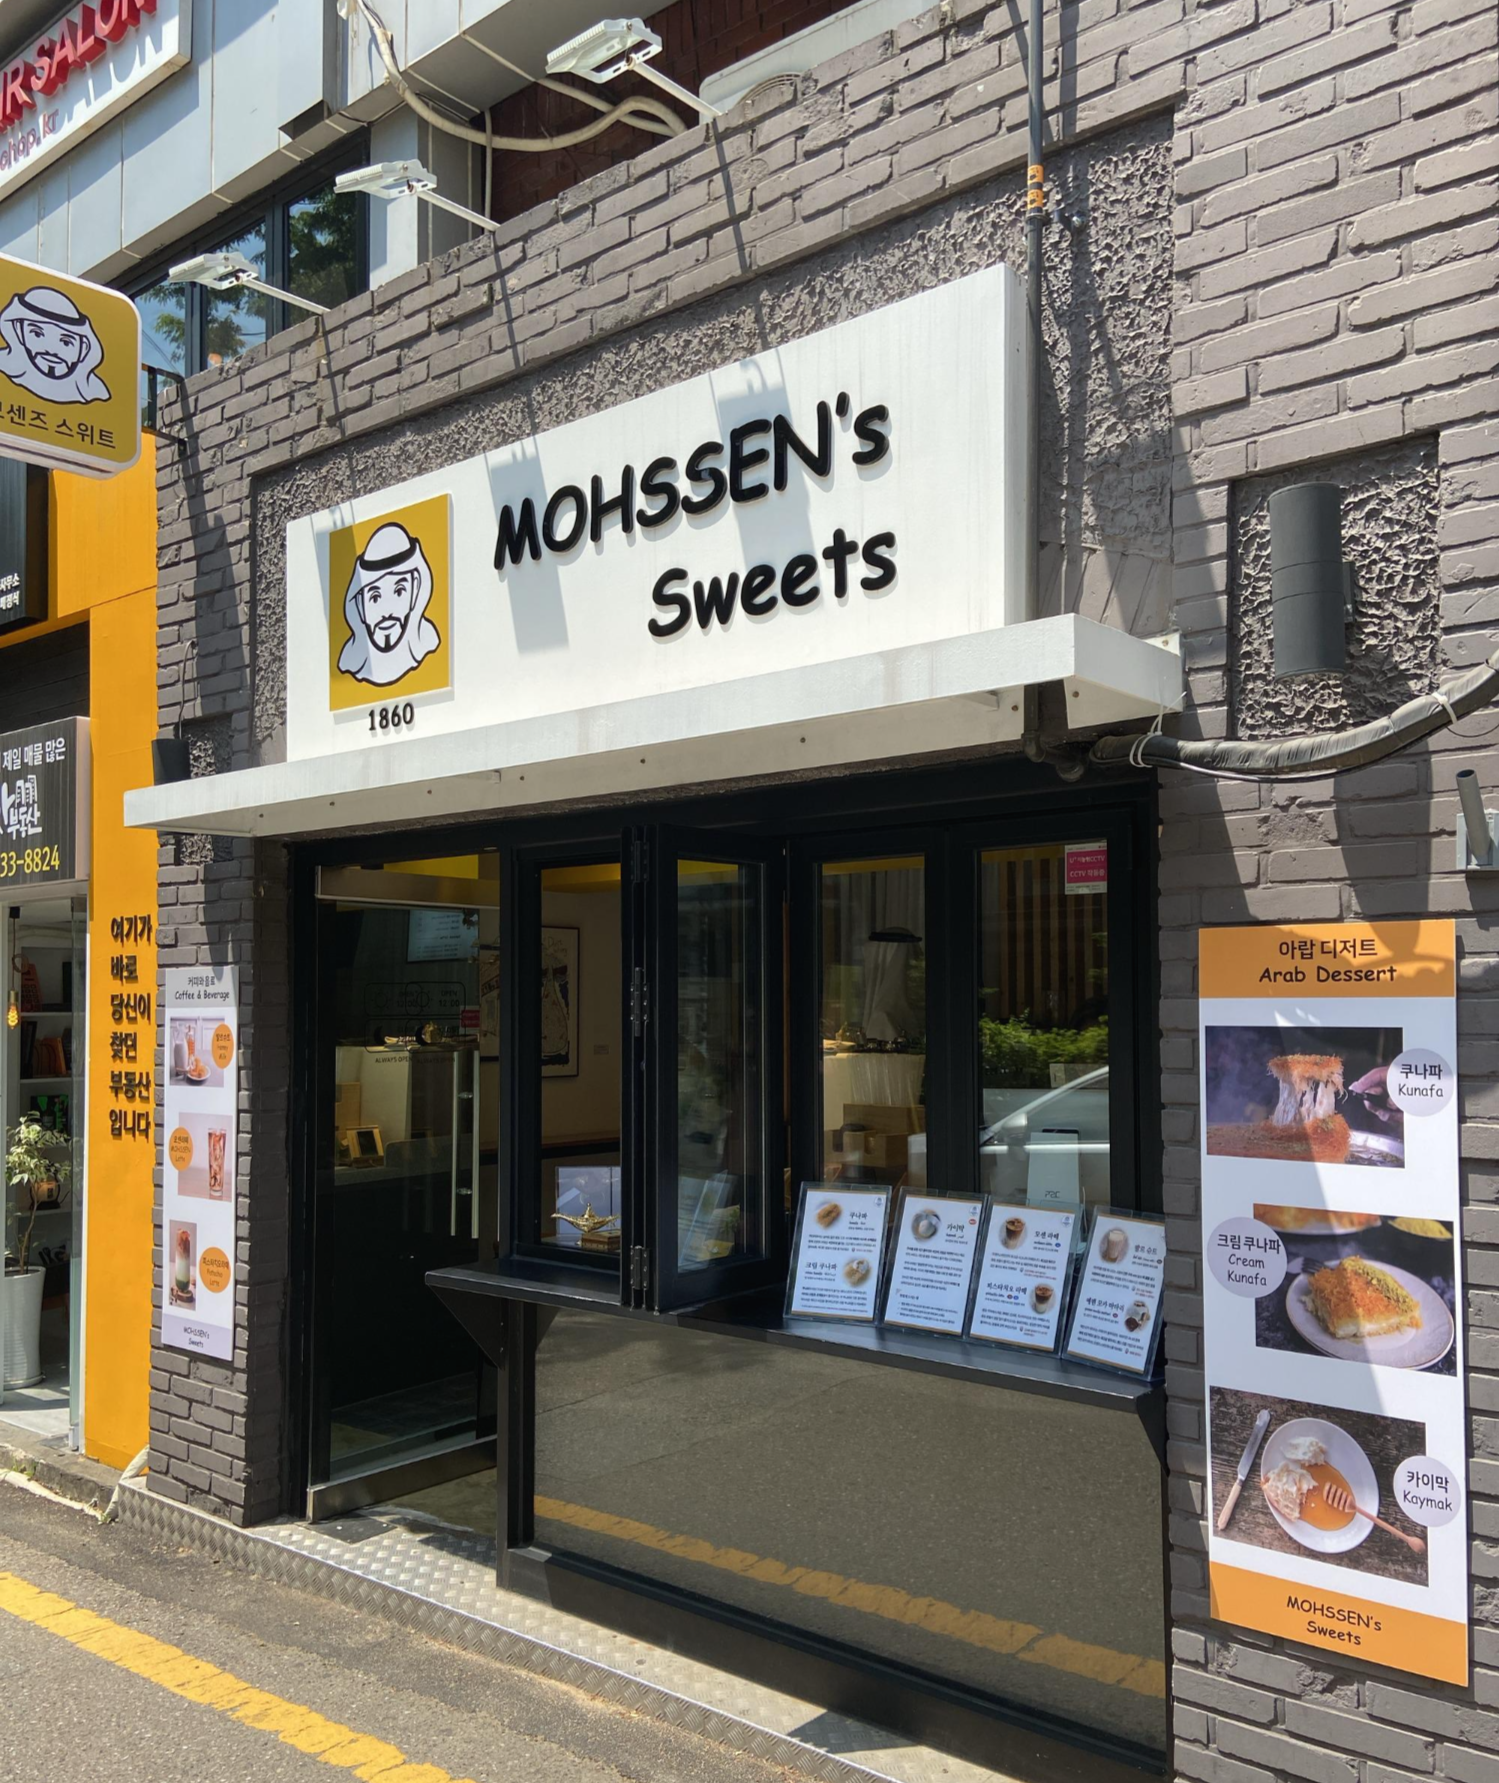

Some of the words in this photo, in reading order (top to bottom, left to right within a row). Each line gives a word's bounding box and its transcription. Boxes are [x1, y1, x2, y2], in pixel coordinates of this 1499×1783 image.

[54, 418, 116, 449] 스위트
[493, 392, 889, 572] MOHSSEN's
[648, 528, 897, 638] Sweets
[367, 703, 415, 732] 1860
[2, 746, 21, 771] 제일
[24, 742, 43, 766] 매물
[45, 737, 66, 763] 많은
[110, 914, 152, 948] 여기가
[1279, 939, 1316, 960] 아랍
[1321, 938, 1378, 958] 디저트
[110, 954, 139, 986] 바로
[1259, 966, 1306, 983] Arab
[1316, 965, 1397, 983] Dessert
[110, 992, 152, 1026] 당신이
[174, 990, 195, 1000] Coffee
[203, 990, 230, 1001] Beverage
[109, 1031, 138, 1063] 찾던
[1400, 1063, 1443, 1080] 쿠나파
[109, 1070, 151, 1103] 부동산
[1398, 1083, 1444, 1098] Kunafa
[109, 1109, 151, 1142] 입니다
[1217, 1233, 1241, 1250] 크림
[1243, 1235, 1281, 1254] 쿠나파
[1228, 1253, 1265, 1270] Cream
[1227, 1270, 1267, 1287] Kunafa
[1406, 1470, 1450, 1494] 카이막
[1403, 1490, 1453, 1512] Kaymak
[1286, 1595, 1382, 1632] MOHSSEN's
[1306, 1620, 1362, 1646] Sweets
